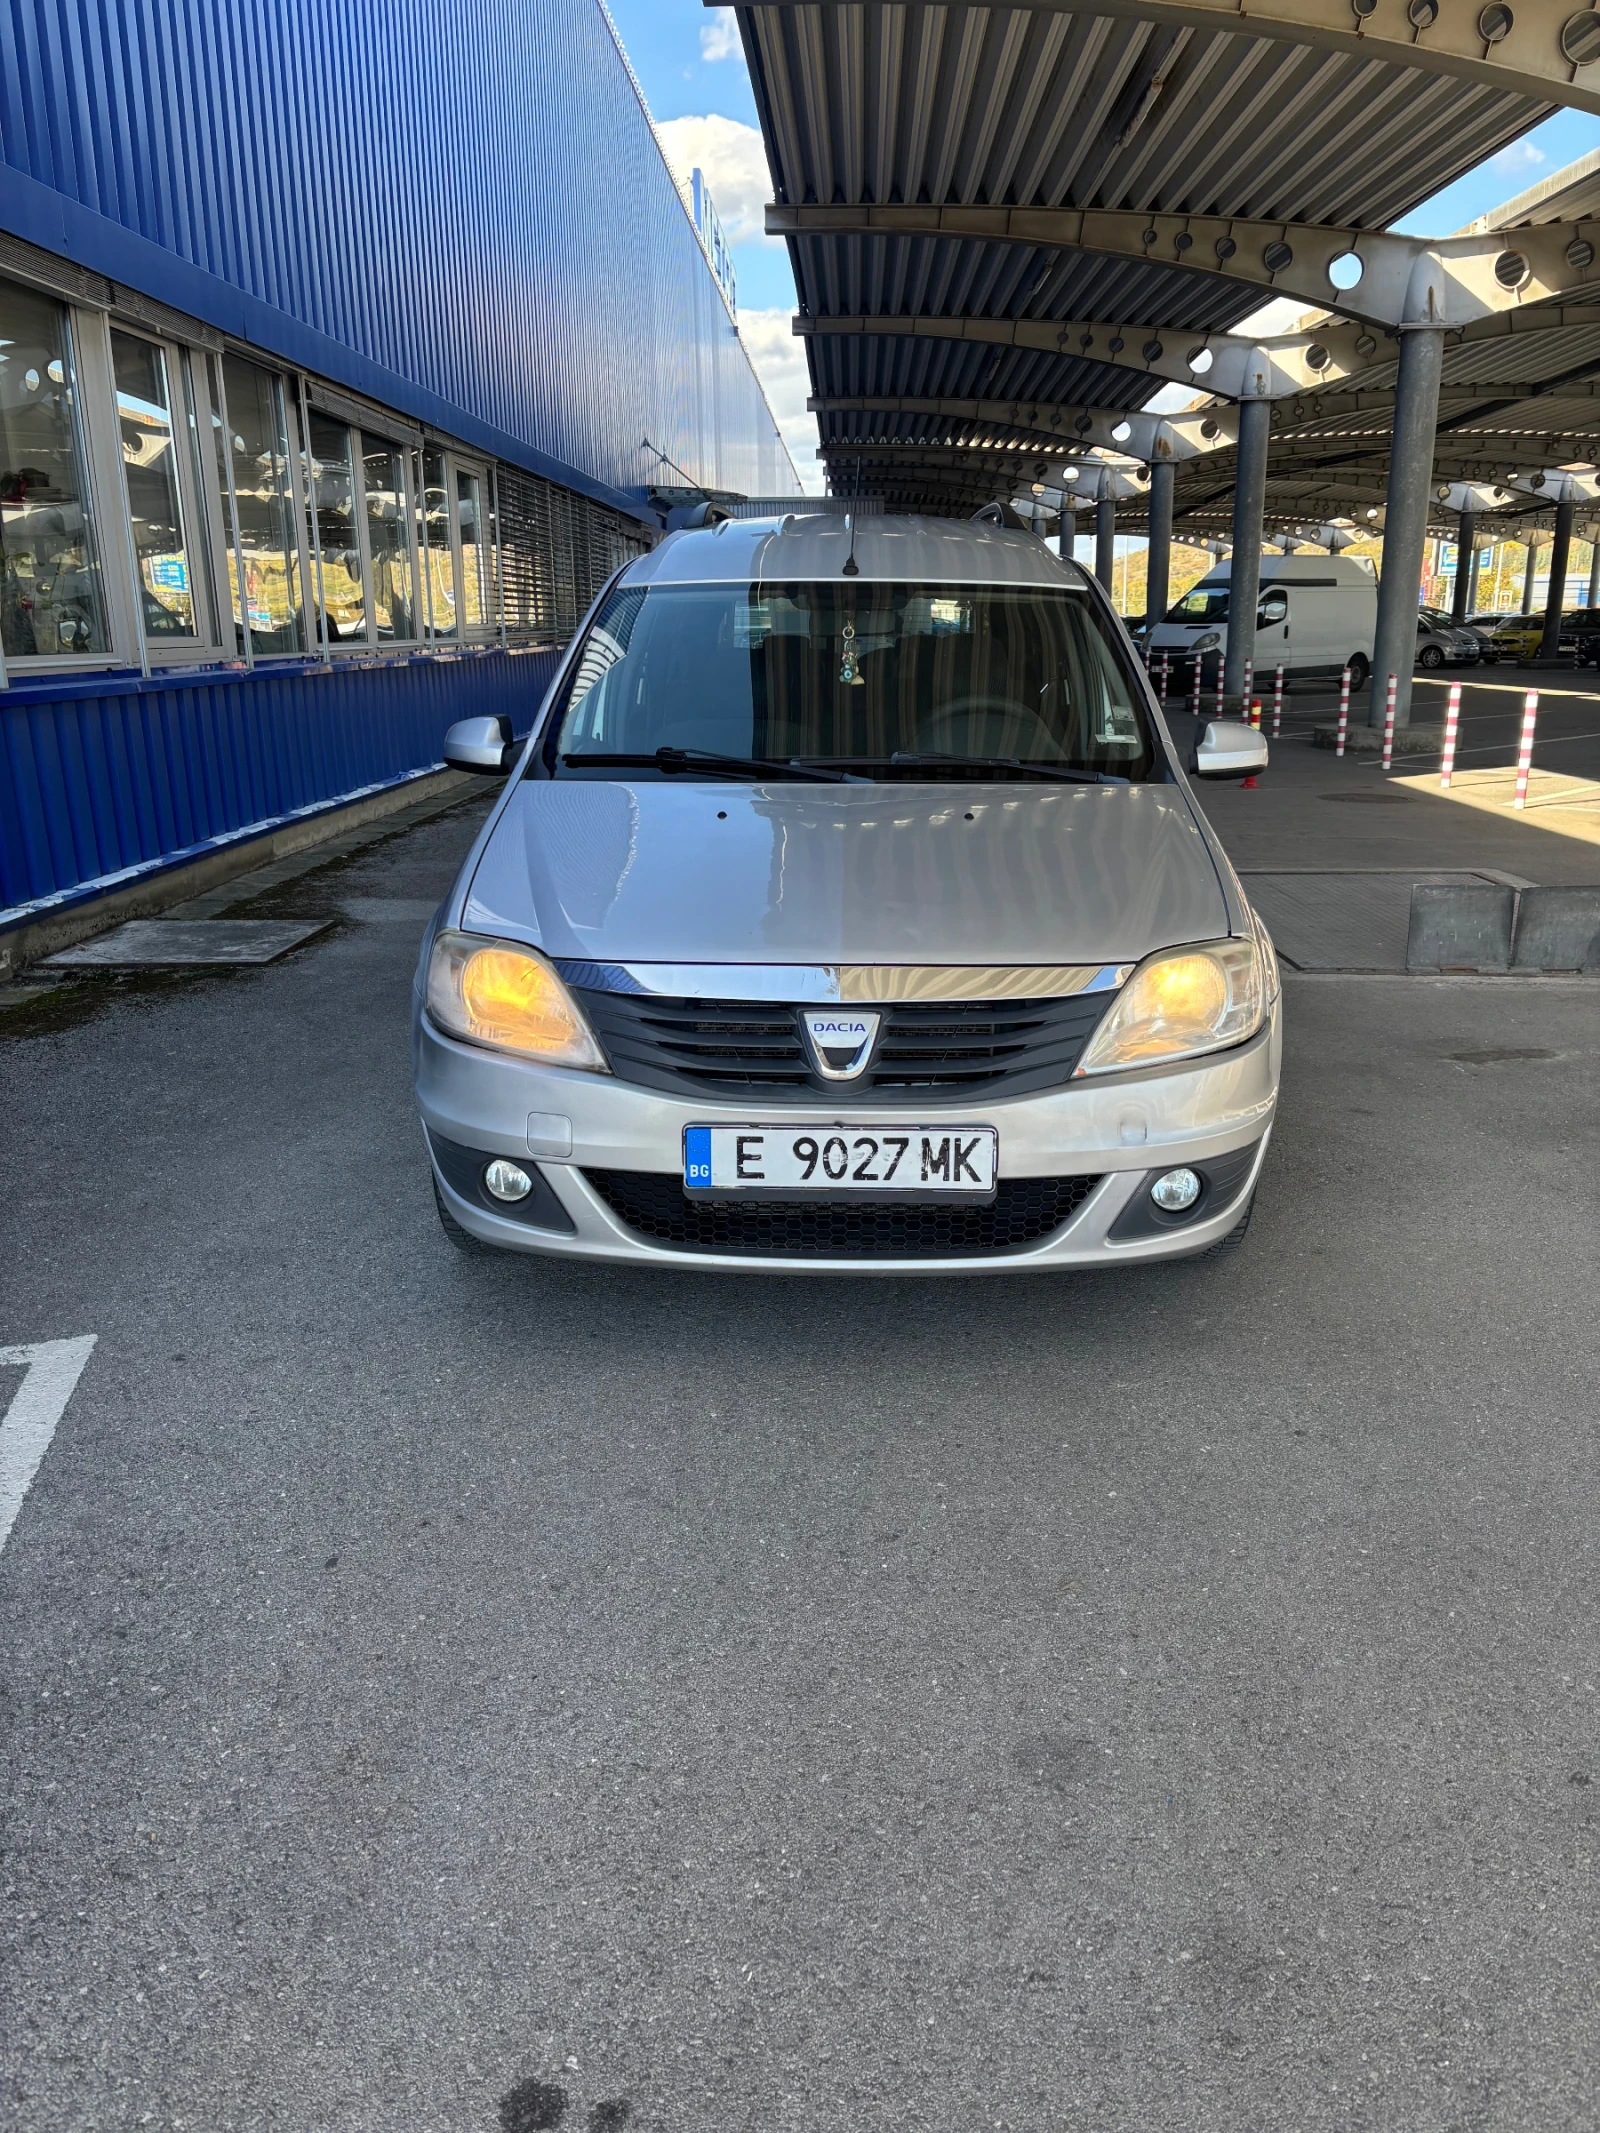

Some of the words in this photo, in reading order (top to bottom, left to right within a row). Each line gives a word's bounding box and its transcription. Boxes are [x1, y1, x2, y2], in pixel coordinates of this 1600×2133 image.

[813, 1022, 867, 1033] DACIA
[736, 1135, 766, 1180] E
[792, 1136, 910, 1181] 9027
[920, 1137, 983, 1183] MK
[689, 1164, 710, 1178] BG
